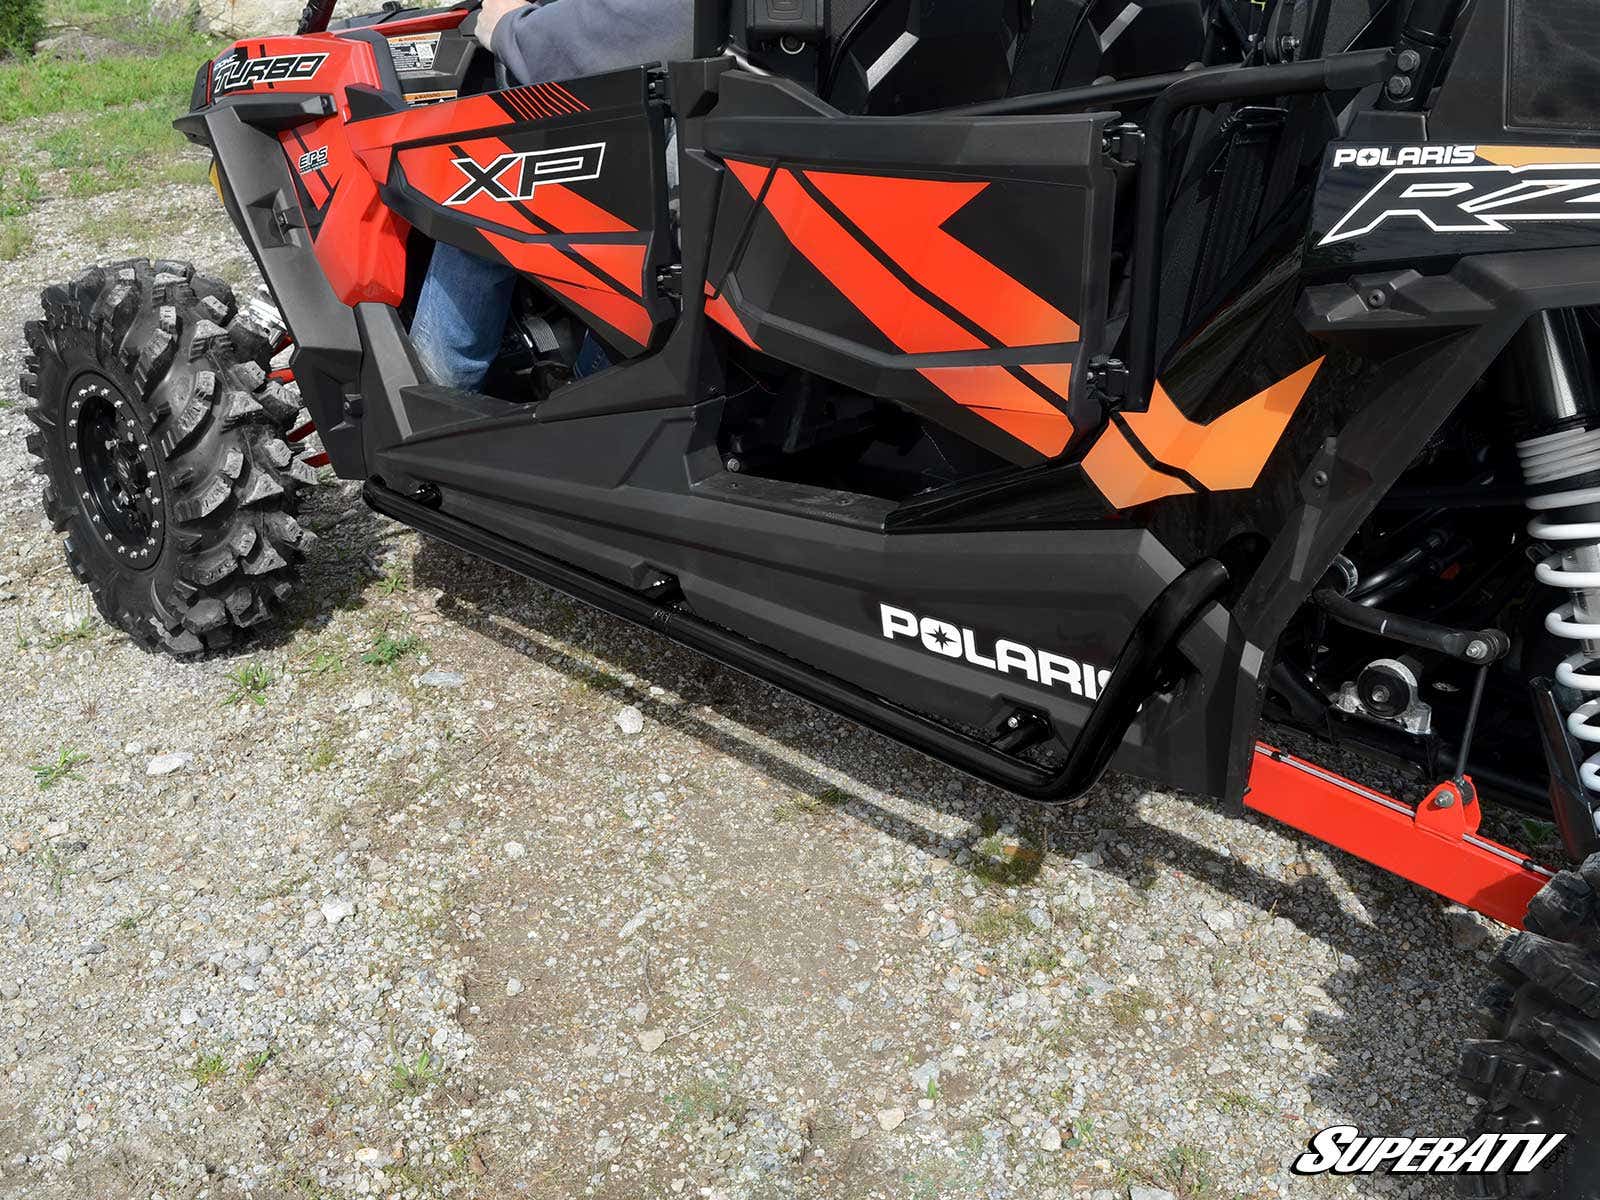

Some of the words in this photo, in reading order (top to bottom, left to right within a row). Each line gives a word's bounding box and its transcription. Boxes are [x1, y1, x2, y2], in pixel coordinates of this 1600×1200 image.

[214, 53, 329, 94] TURBO
[299, 146, 328, 168] EPS
[1333, 145, 1476, 167] POLARIS
[442, 142, 606, 206] XP
